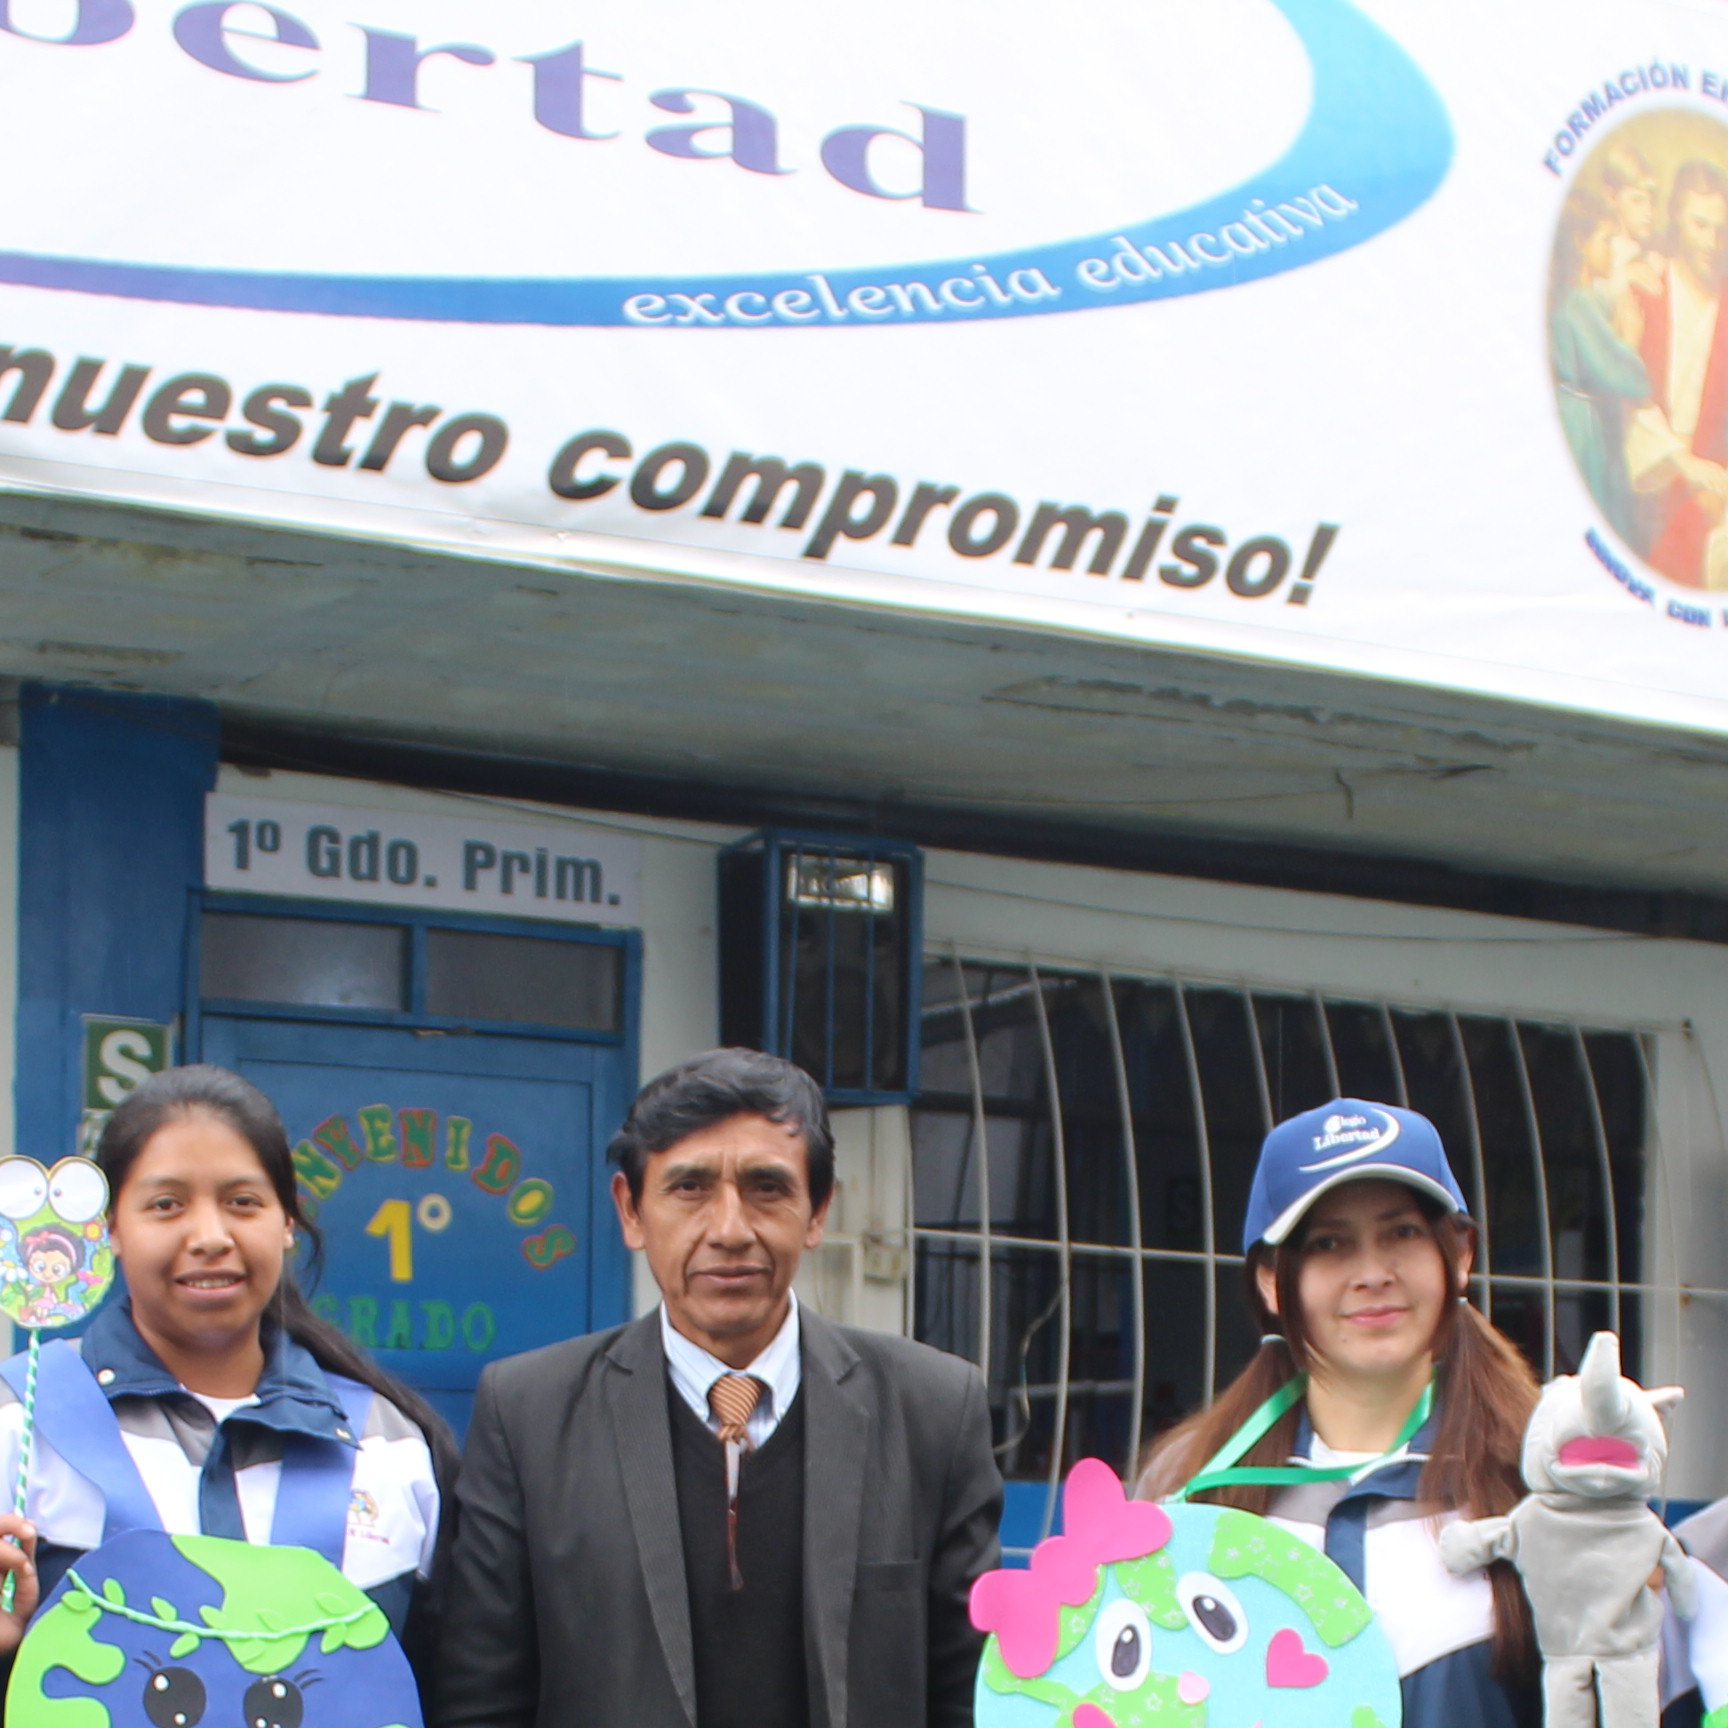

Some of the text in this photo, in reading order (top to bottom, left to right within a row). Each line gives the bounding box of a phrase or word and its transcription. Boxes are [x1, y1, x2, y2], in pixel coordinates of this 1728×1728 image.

[1543, 55, 1690, 178] FORMACIÓN
[621, 181, 1360, 326] excelencia educativa
[547, 427, 1341, 608] compromiso!
[306, 823, 439, 888] Gdo.
[463, 839, 621, 906] Prim.
[97, 1029, 152, 1103] S
